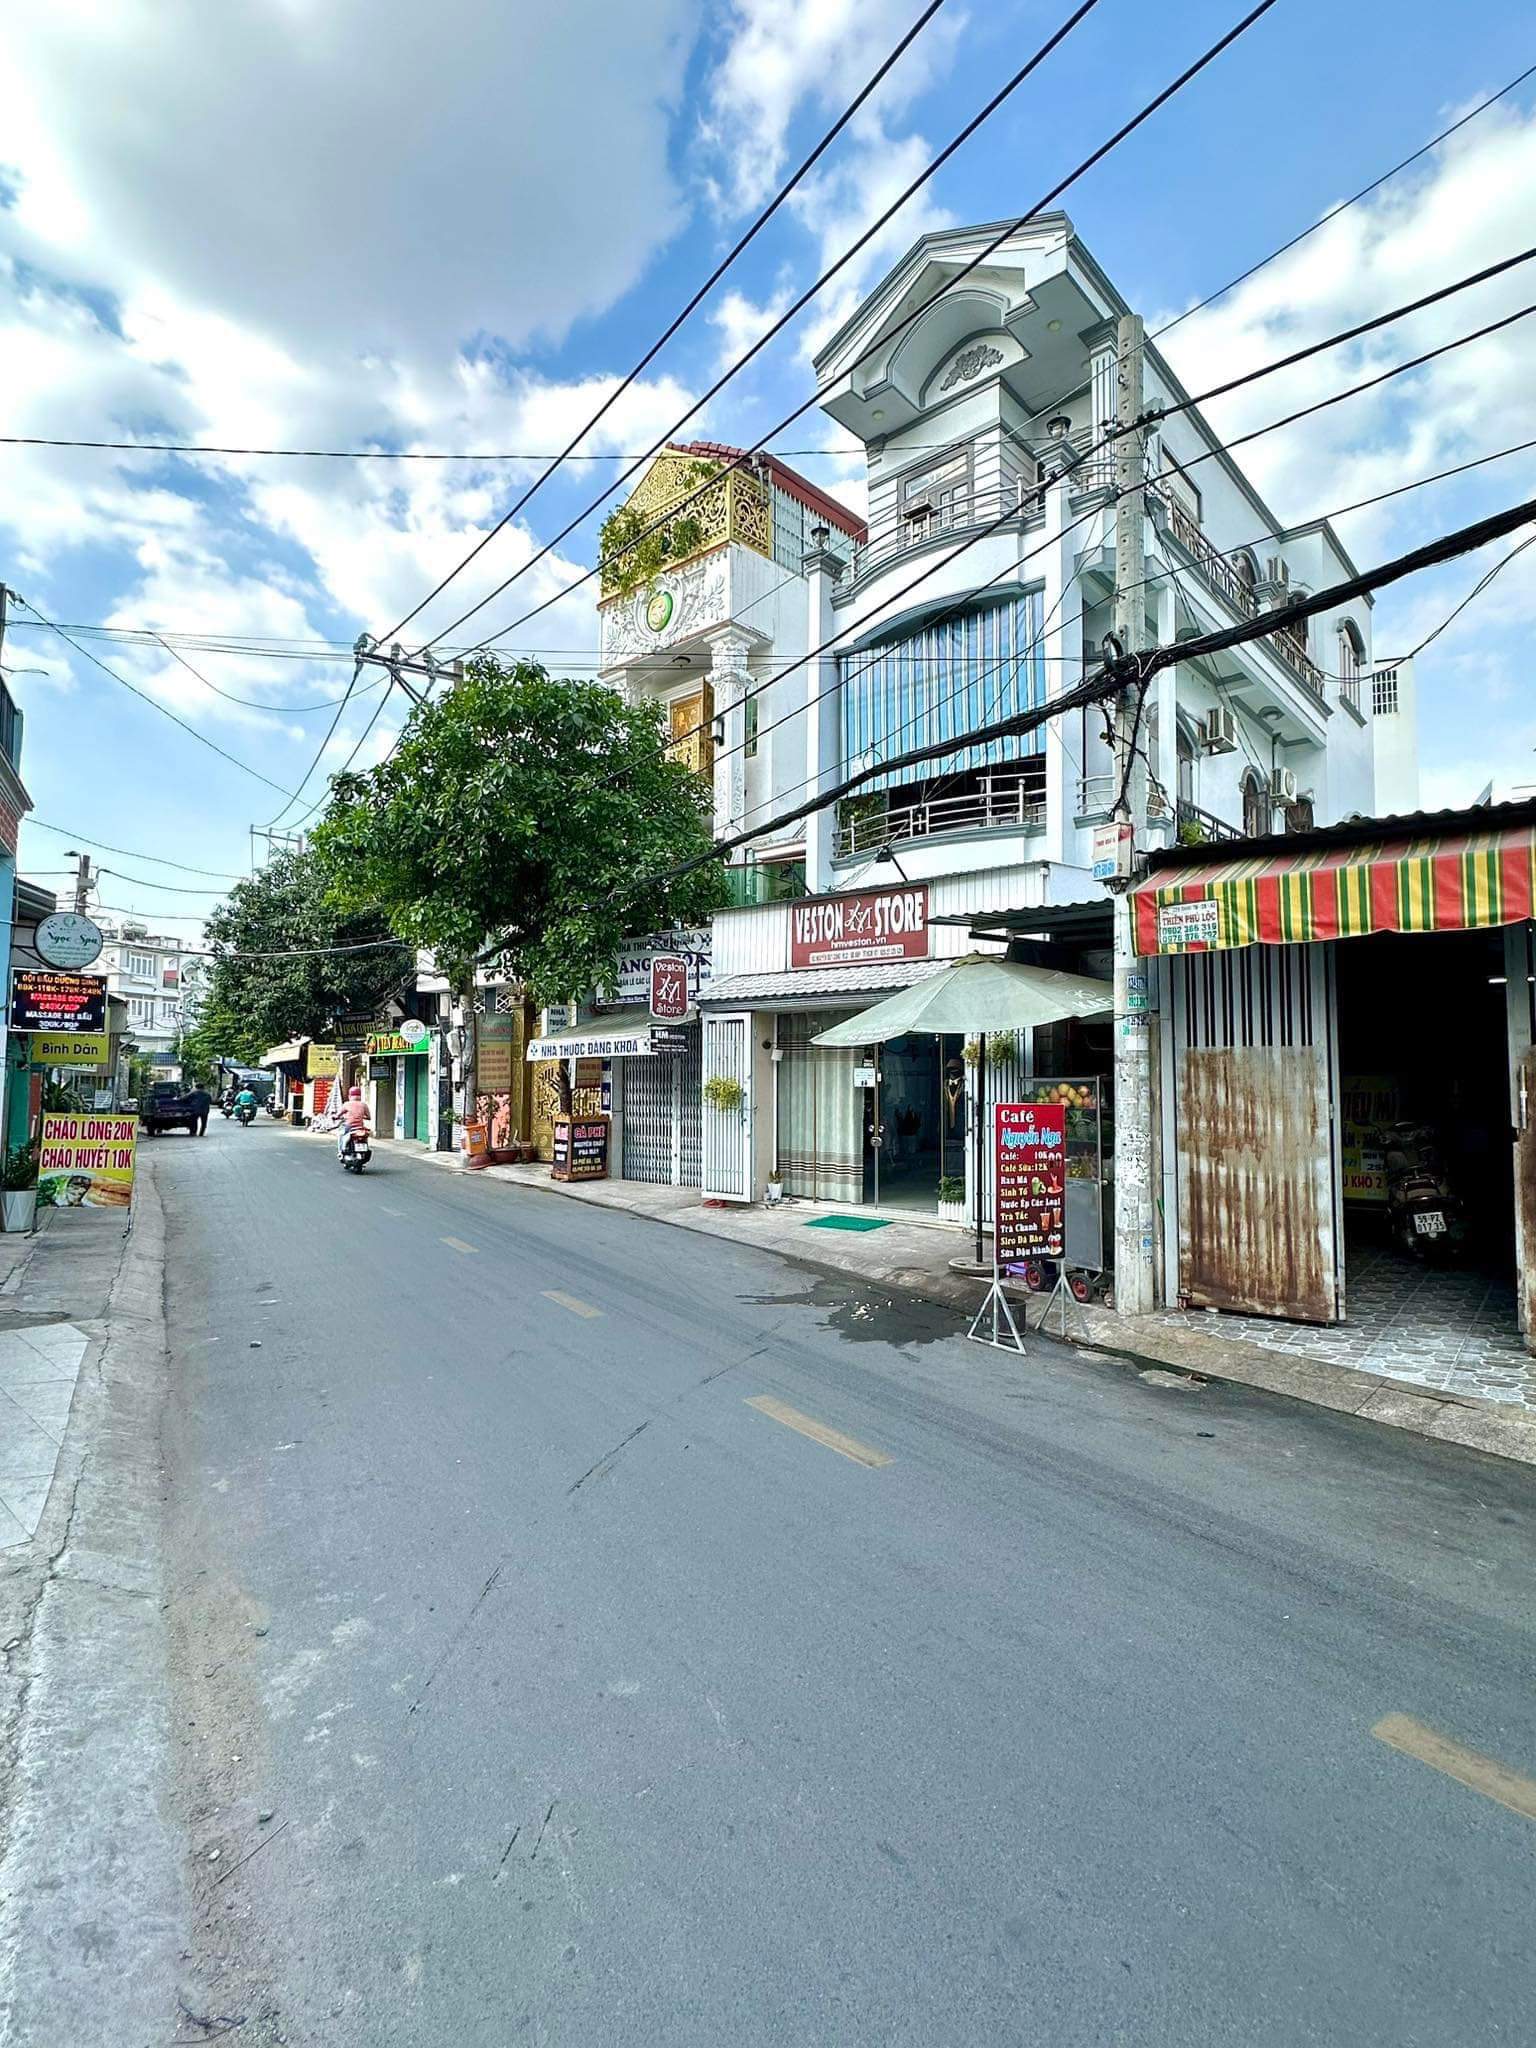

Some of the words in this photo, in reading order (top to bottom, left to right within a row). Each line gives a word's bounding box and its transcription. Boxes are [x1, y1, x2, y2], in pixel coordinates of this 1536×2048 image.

[795, 903, 843, 944] VESTON
[874, 892, 924, 938] STORE
[618, 957, 650, 974] ĂNG
[655, 961, 685, 973] Veston
[656, 1003, 683, 1014] Store
[25, 1011, 63, 1019] MASSAGE
[42, 1043, 69, 1055] Bình
[73, 1043, 98, 1055] Dân
[614, 1039, 638, 1053] KHOA
[1001, 1109, 1034, 1123] Café
[44, 1115, 77, 1140] CHÁO
[82, 1115, 112, 1141] LÒNG
[113, 1121, 135, 1141] 20K
[42, 1144, 72, 1168] CHÁO
[75, 1143, 109, 1168] HUYẾT
[112, 1148, 132, 1168] 10K
[1001, 1188, 1017, 1197] Sinh
[1000, 1212, 1014, 1221] Trà
[1000, 1224, 1014, 1233] Trà
[1015, 1222, 1038, 1232] Chanh
